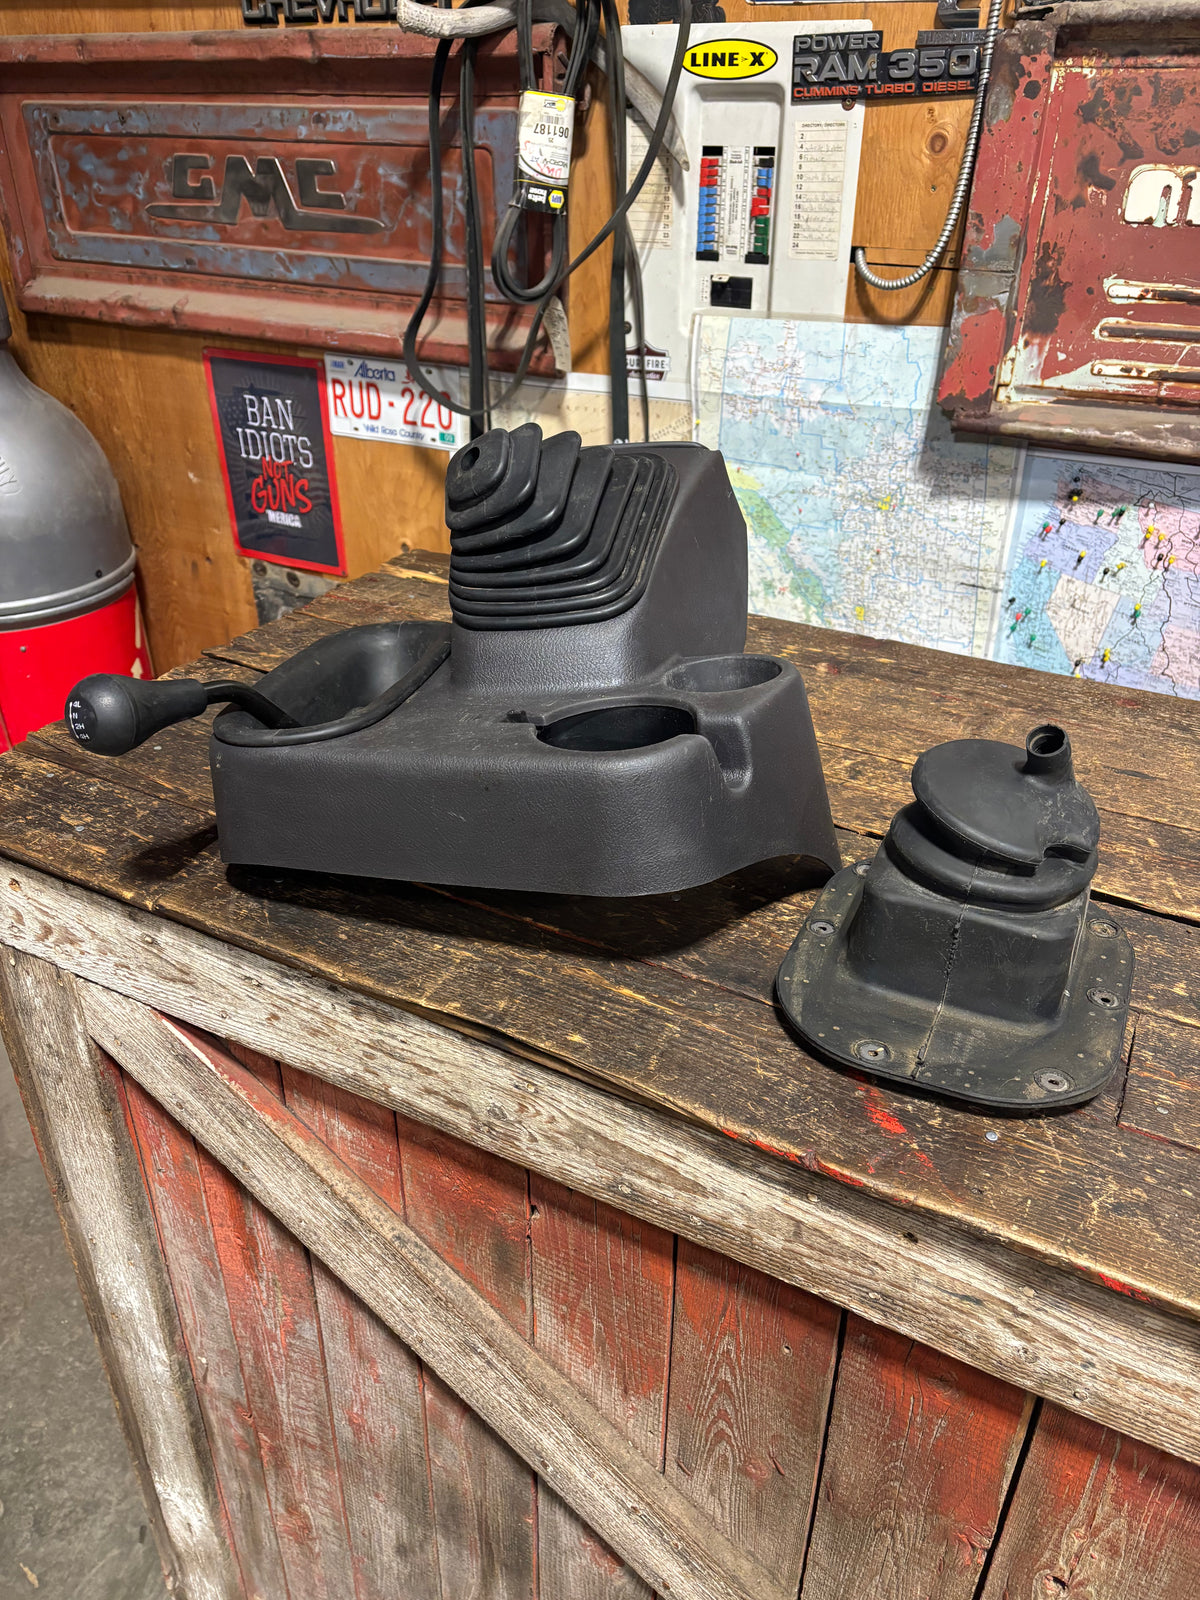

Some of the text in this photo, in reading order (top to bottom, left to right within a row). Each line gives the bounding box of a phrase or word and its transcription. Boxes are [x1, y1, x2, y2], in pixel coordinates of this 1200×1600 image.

[795, 32, 881, 51] POWER
[793, 46, 979, 83] RAM 350
[793, 80, 976, 98] CUMMINS TURBO DIESEL
[533, 123, 570, 138] 061187
[147, 152, 384, 233] GMC
[354, 360, 396, 382] Alberta
[646, 358, 666, 369] FIRE
[243, 394, 294, 431] BAN
[363, 424, 379, 434] Wild
[399, 428, 425, 441] Country
[236, 428, 314, 468] IDIOTS
[261, 454, 294, 482] NOT
[251, 478, 313, 514] GUNS
